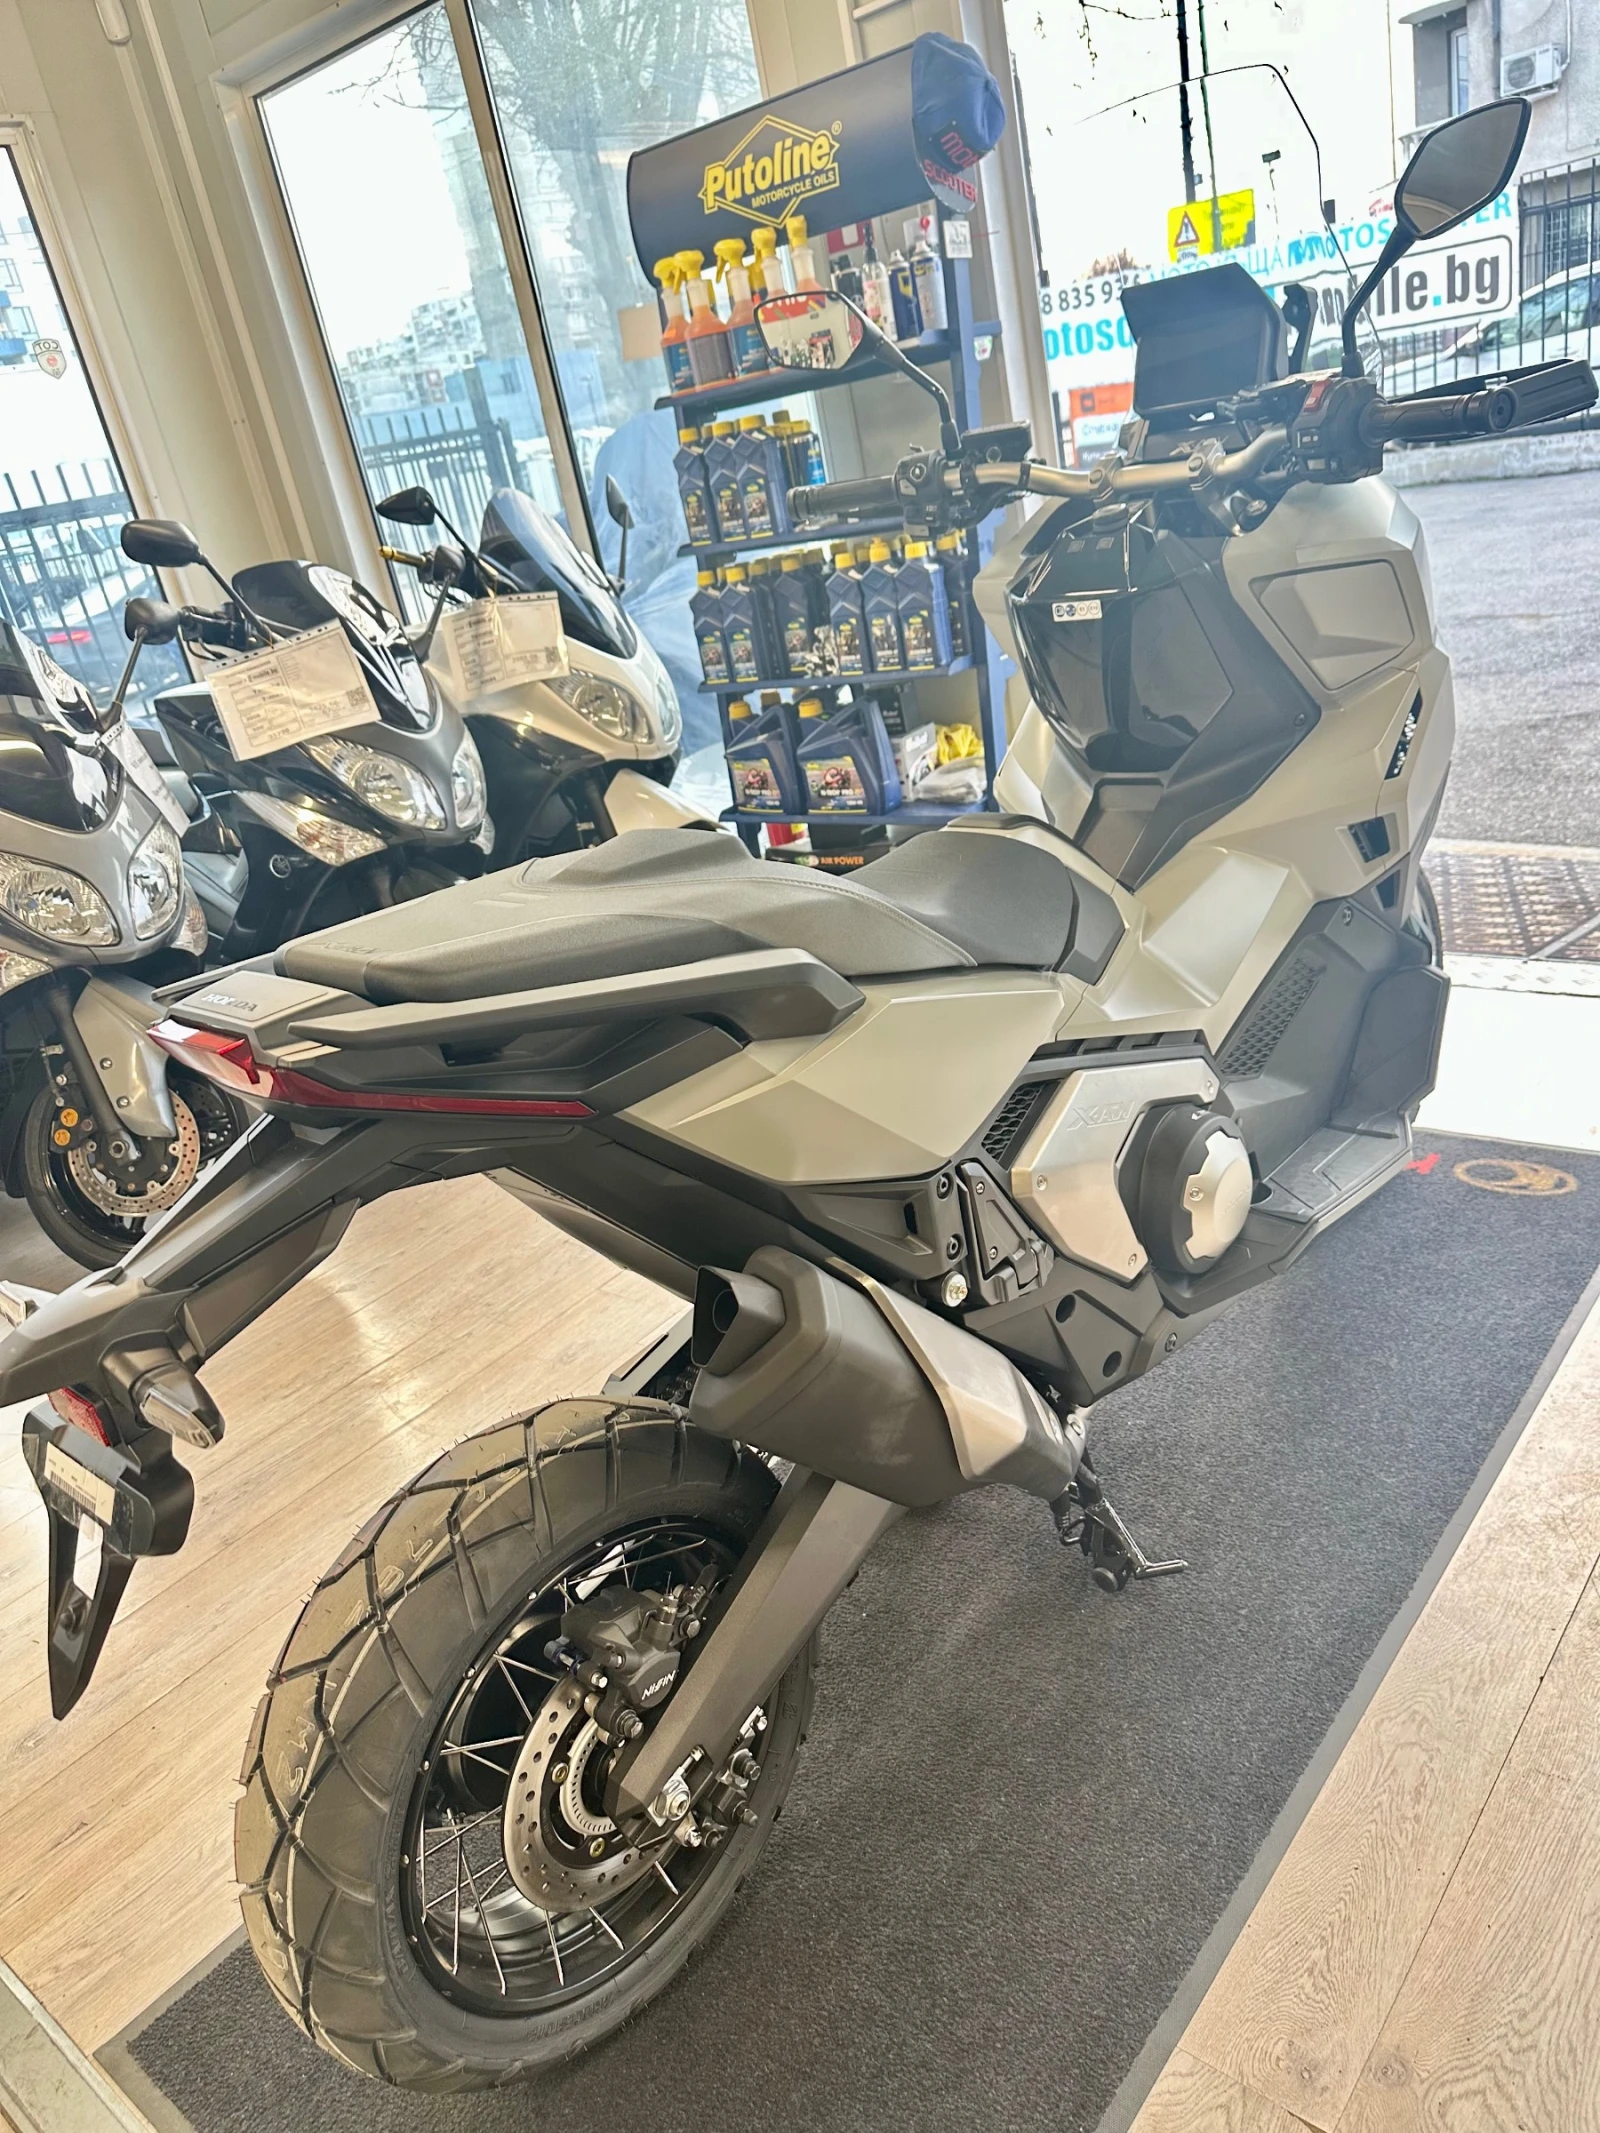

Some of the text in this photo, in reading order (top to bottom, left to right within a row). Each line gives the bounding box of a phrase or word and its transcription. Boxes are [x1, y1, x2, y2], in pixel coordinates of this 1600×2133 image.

[706, 134, 830, 208] Putoline
[751, 170, 835, 208] MOTORCYCLE OILS
[1058, 284, 1096, 312] 835
[820, 856, 834, 866] AIR
[834, 855, 864, 866] POWER
[201, 992, 259, 1012] HONDA
